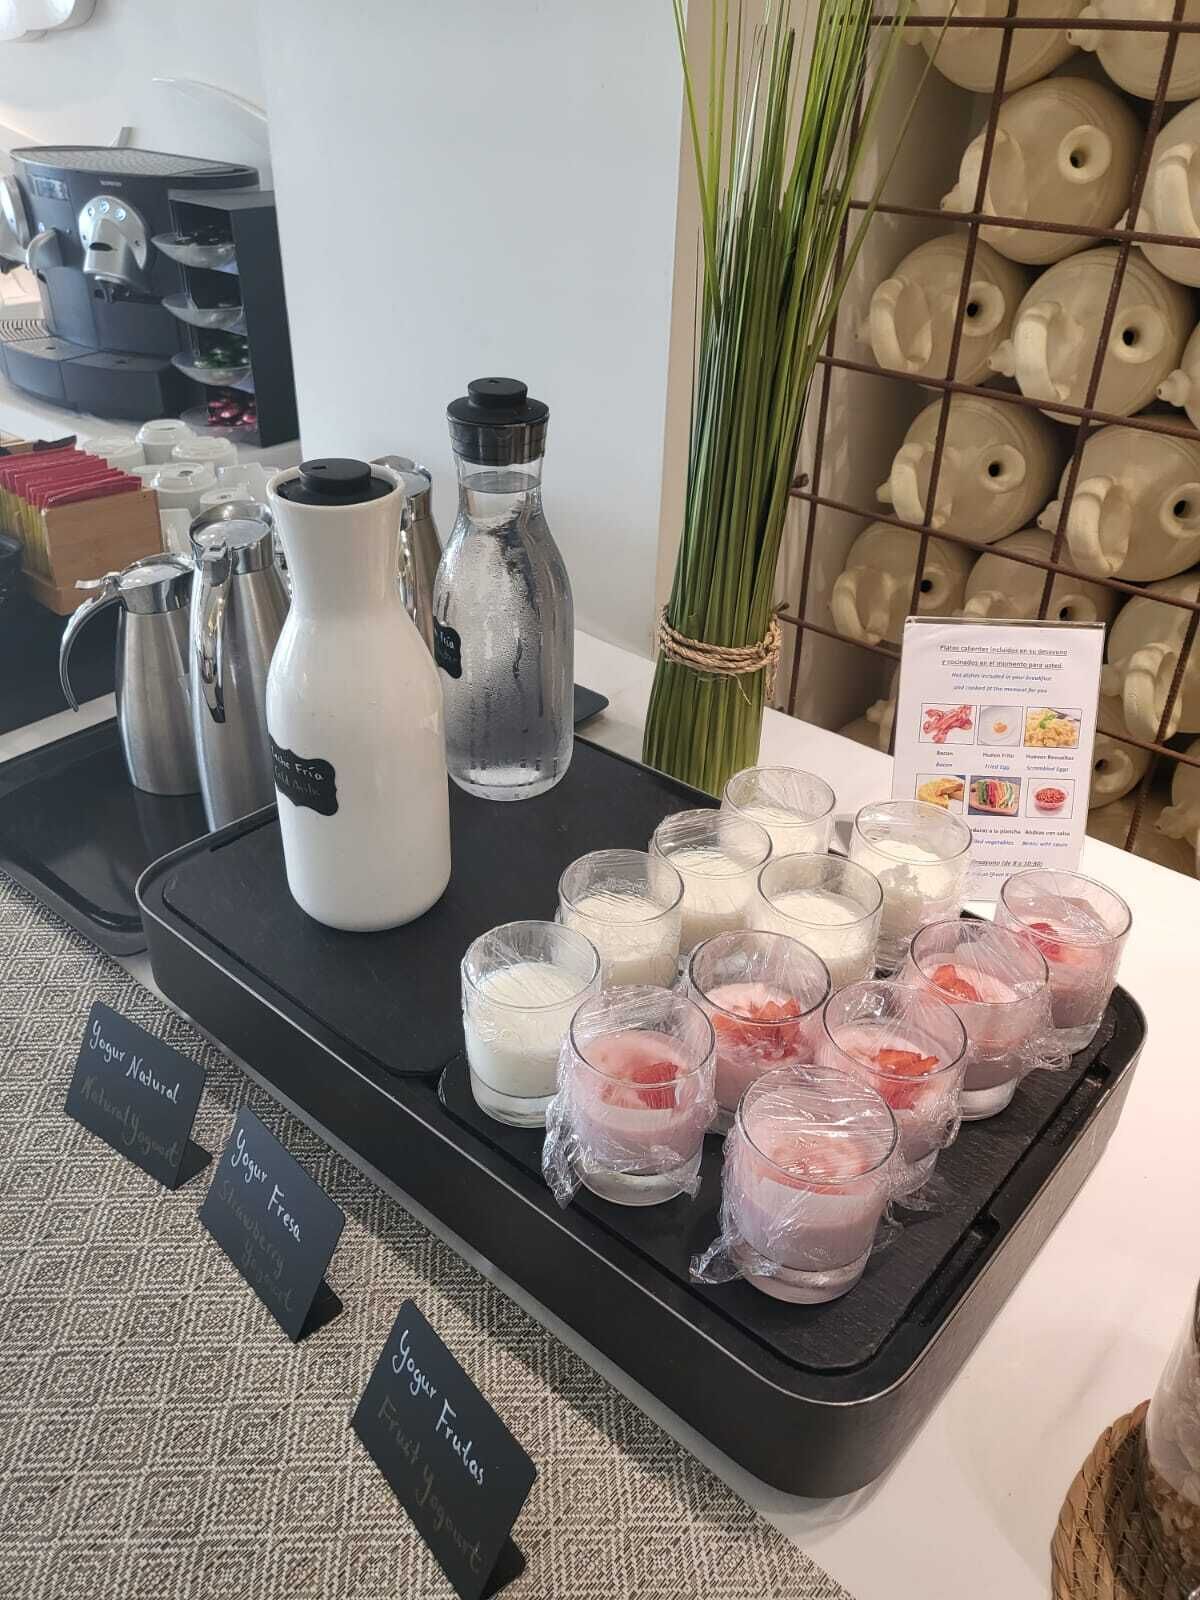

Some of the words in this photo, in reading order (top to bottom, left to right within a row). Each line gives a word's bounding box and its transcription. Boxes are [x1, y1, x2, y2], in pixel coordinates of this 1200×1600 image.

[80, 1074, 130, 1126] Natural
[89, 1019, 126, 1063] Yogur
[125, 1055, 180, 1104] Natural
[231, 1128, 268, 1184] Yogur
[267, 1184, 301, 1242] Fresa
[377, 1395, 422, 1465] Fruit
[392, 1328, 437, 1400] Yogur
[435, 1399, 485, 1486] Frutas
